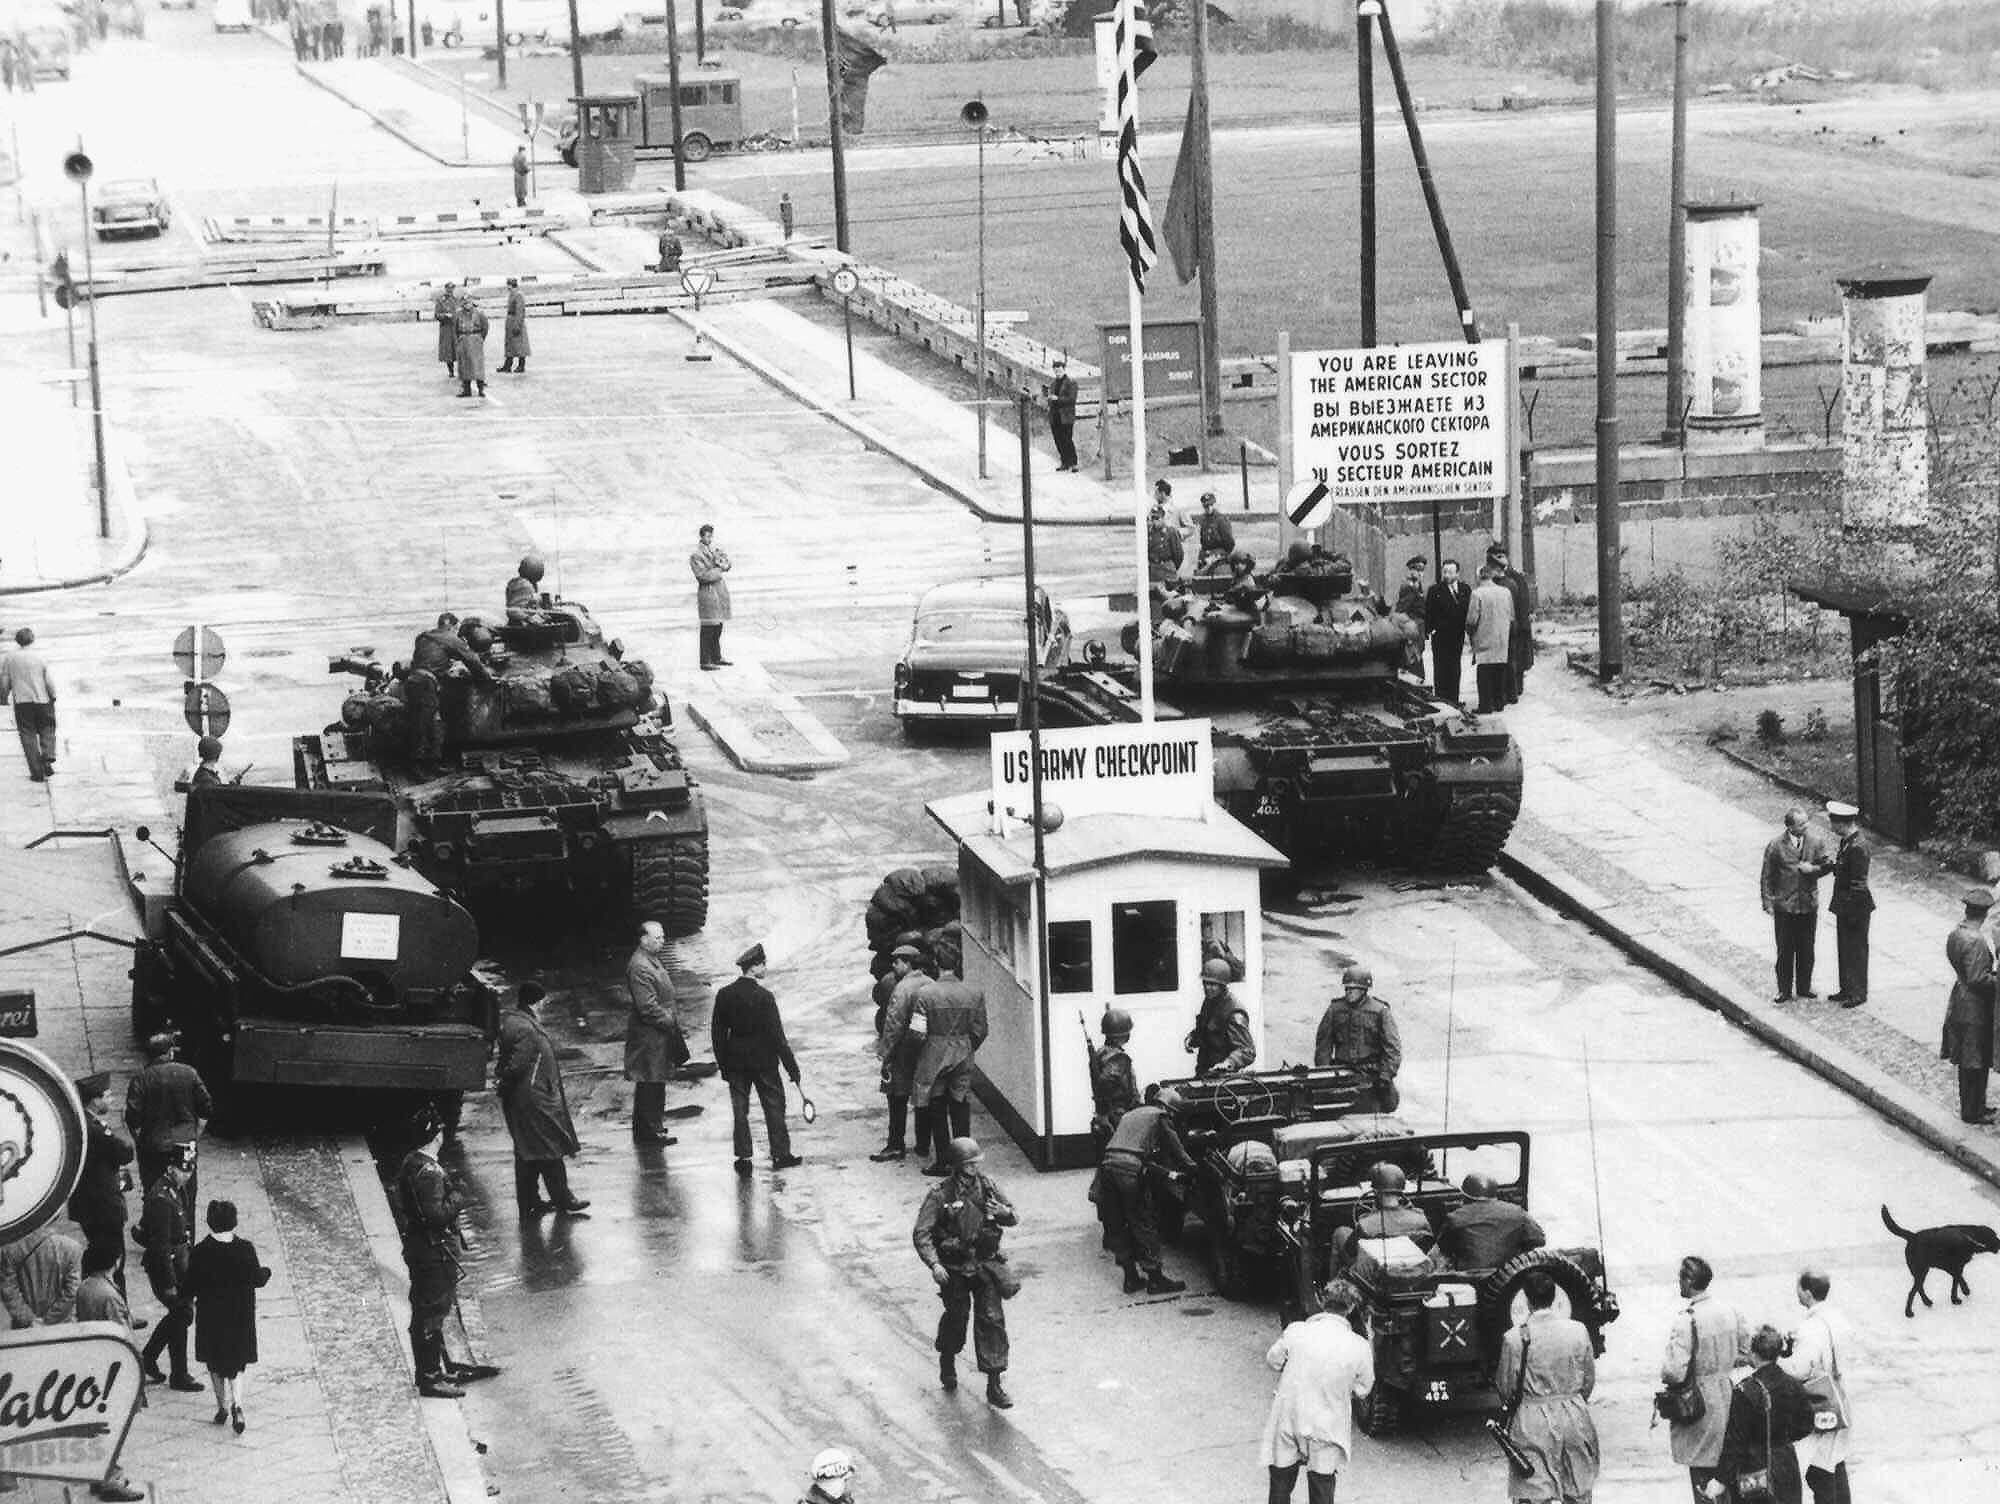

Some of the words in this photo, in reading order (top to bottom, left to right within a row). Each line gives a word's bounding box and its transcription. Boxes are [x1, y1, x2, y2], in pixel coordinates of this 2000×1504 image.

[1319, 356, 1353, 372] YOU
[1363, 355, 1397, 371] ARE
[1408, 351, 1478, 370] LEAVING
[1310, 377, 1336, 393] THE
[1344, 374, 1422, 392] AMERICAN
[1431, 371, 1488, 388] SECTOR
[1313, 402, 1340, 418] ВЫ
[1349, 396, 1453, 416] ВЫЕЗЖАЕТЕ
[1463, 395, 1485, 411] ИЗ
[1310, 417, 1425, 439] АМЕРИКАНСКОГО
[1431, 415, 1490, 433] СЕКТОРА
[1338, 444, 1385, 462] VOUS
[1396, 441, 1460, 460] SORTEZ
[1337, 464, 1404, 483] SECTEUR
[1411, 460, 1493, 479] AMERICAIN
[1038, 747, 1087, 781] ARMY
[1096, 741, 1199, 778] CHECKPOINT
